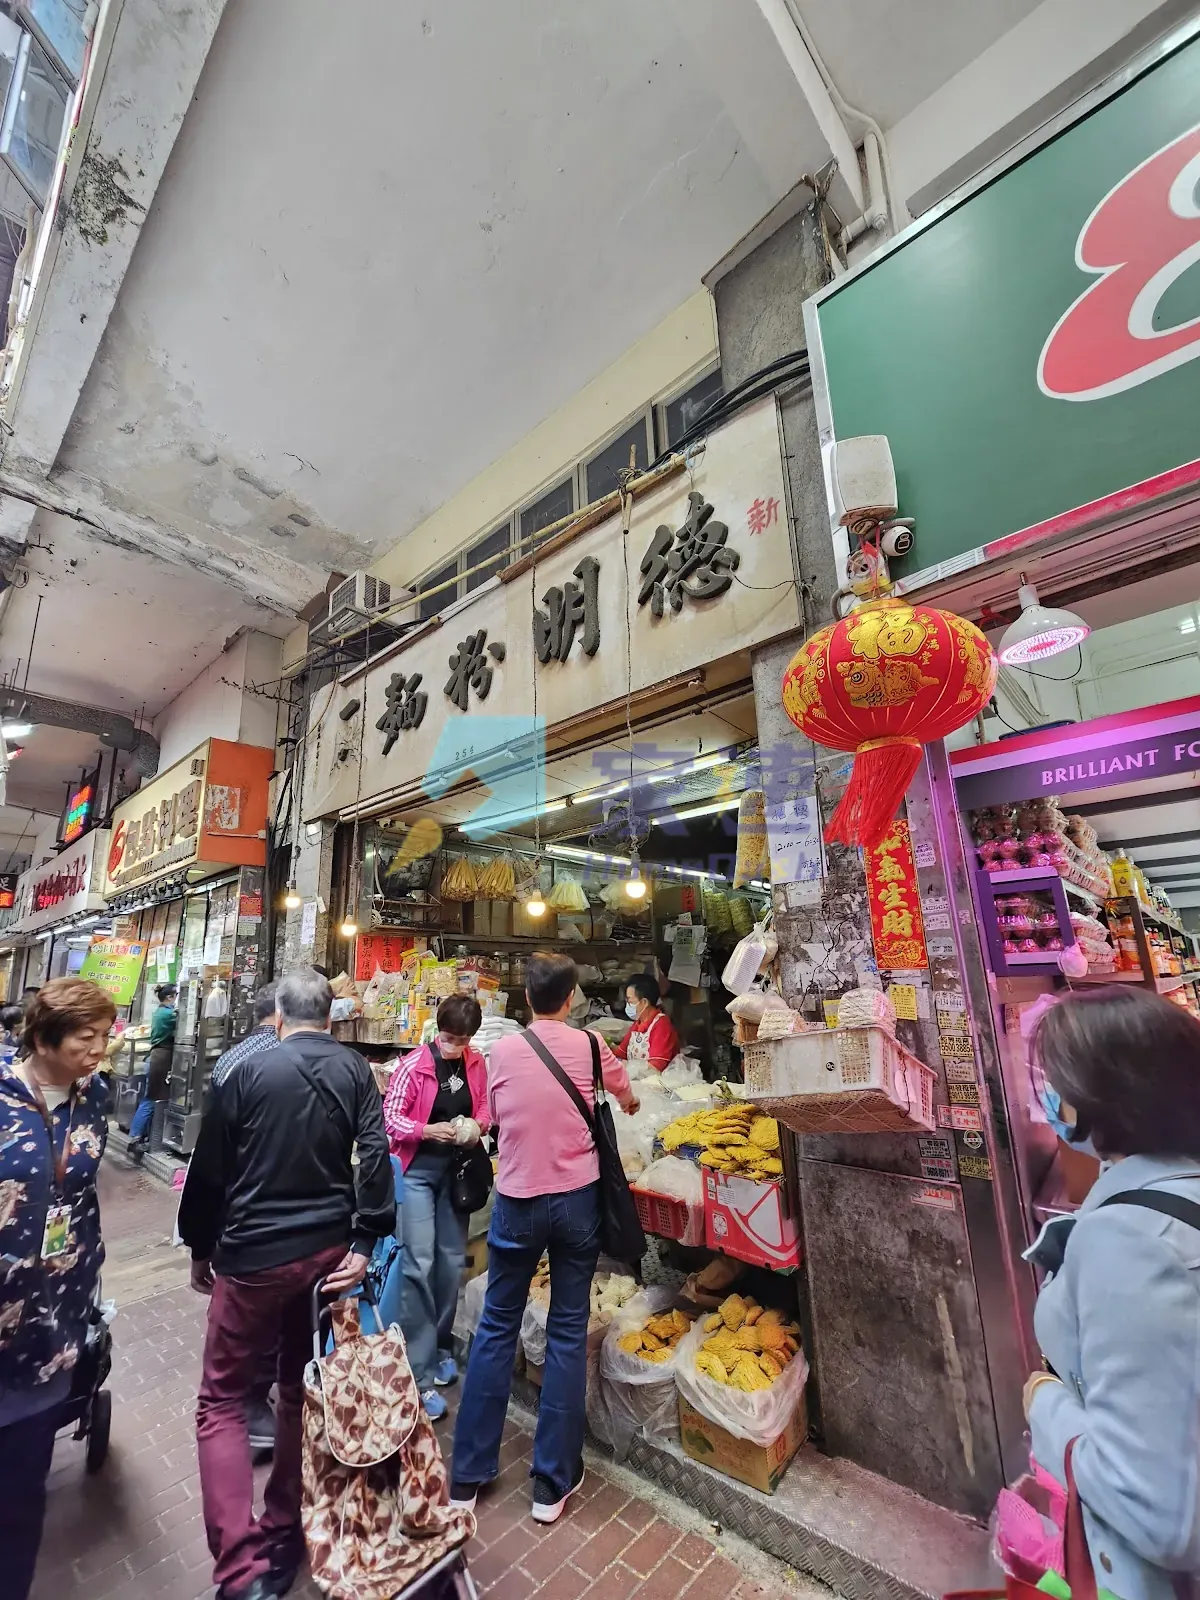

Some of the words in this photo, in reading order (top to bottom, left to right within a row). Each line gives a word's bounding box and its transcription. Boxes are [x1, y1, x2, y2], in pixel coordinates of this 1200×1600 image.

[747, 496, 781, 536] 新
[847, 607, 928, 659] 福
[1041, 748, 1160, 786] BRILLIANT
